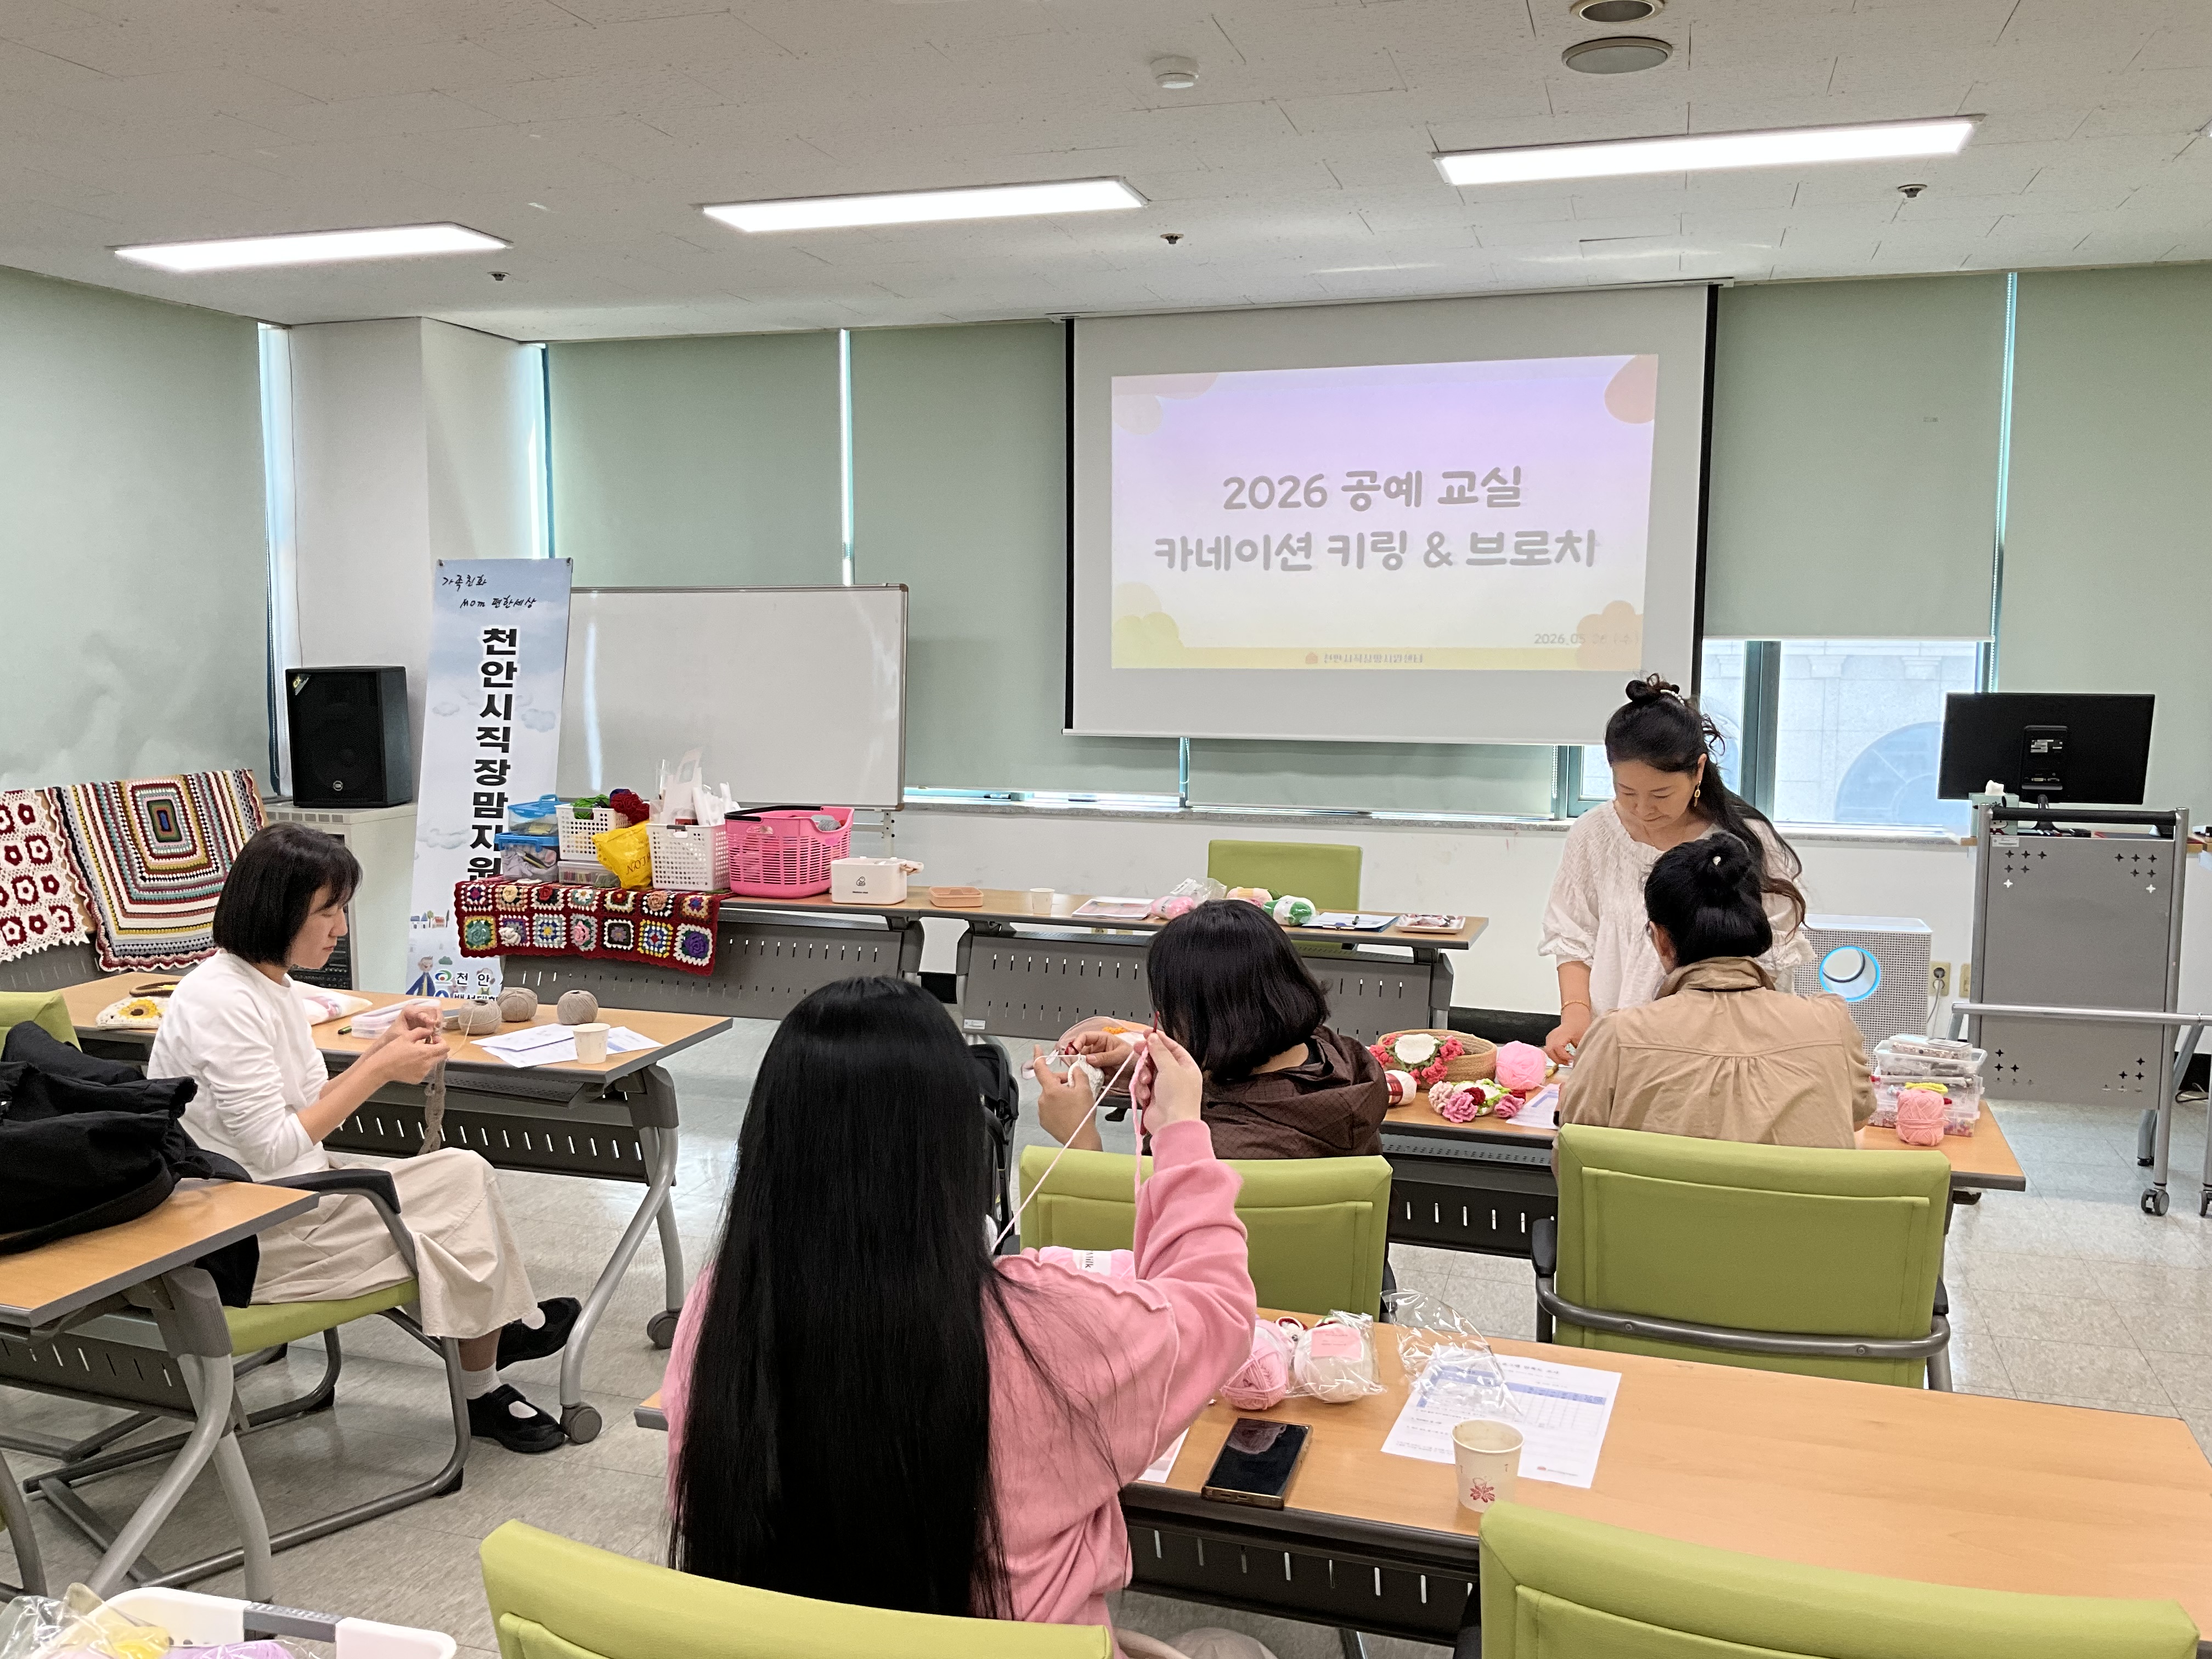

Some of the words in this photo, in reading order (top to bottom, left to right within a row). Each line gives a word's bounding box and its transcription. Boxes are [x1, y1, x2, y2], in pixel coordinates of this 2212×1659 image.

[1223, 473, 1328, 510] 2026
[1341, 470, 1423, 512] 공예
[1437, 466, 1522, 508] 교실
[1154, 531, 1312, 572] 카네이션
[1327, 530, 1407, 571] 키링
[1423, 531, 1453, 568] &
[1466, 529, 1595, 567] 브로치
